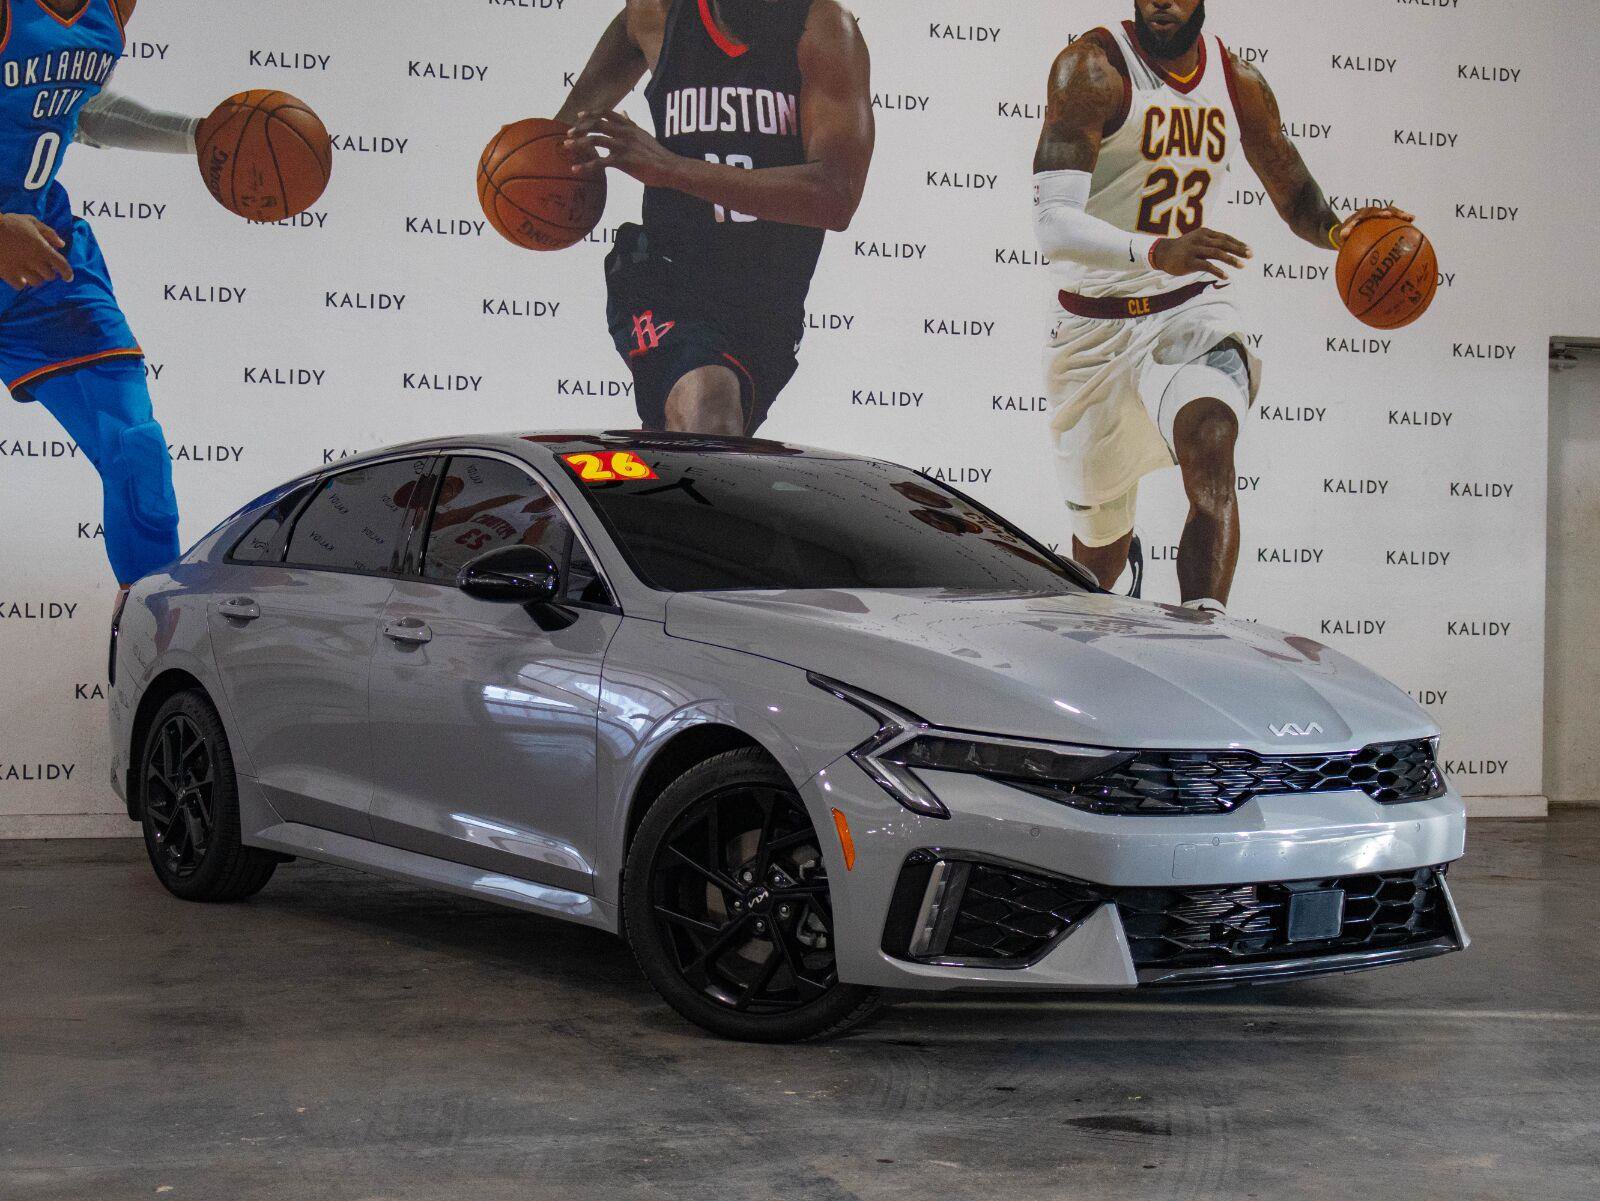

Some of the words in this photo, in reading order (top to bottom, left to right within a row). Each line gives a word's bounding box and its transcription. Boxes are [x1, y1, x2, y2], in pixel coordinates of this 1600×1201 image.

[930, 24, 1000, 42] KALIDY
[120, 43, 169, 59] IDY
[4, 50, 114, 87] OKLAHOM
[250, 50, 330, 70] KALIDY
[1333, 55, 1396, 72] KALIDY
[409, 61, 488, 81] KALIDY
[1459, 65, 1520, 82] KALIDY
[33, 88, 83, 118] CITY
[871, 94, 929, 111] ALIDY
[999, 102, 1048, 118] KALI
[665, 86, 798, 138] HOUSTON
[1140, 105, 1226, 163] CAVS
[1281, 123, 1331, 139] ALIDY
[1395, 130, 1457, 147] KALIDY
[331, 135, 408, 153] KALIDY
[24, 131, 60, 190] 0
[927, 172, 997, 189] KALIDY
[1136, 166, 1212, 238] 23
[1227, 190, 1265, 205] IDY
[83, 201, 166, 220] KALIDY
[1456, 204, 1518, 220] KALIDY
[406, 217, 485, 236] KALIDY
[855, 241, 926, 258] KALIDY
[996, 249, 1050, 265] KALID
[1264, 264, 1328, 280] KALIDY
[165, 285, 246, 303] KALIDY
[326, 292, 405, 309] KALIDY
[483, 299, 559, 317] KALIDY
[1127, 297, 1151, 316] CLE
[802, 314, 854, 330] LIDY
[925, 319, 994, 336] KALIDY
[1327, 338, 1390, 353] KALIDY
[1453, 344, 1515, 359] KALIDY
[245, 368, 325, 385] KALIDY
[404, 373, 482, 391] KALIDY
[558, 380, 634, 396] KALIDY
[853, 391, 923, 407] KALIDY
[993, 396, 1047, 412] KALID
[1261, 406, 1325, 421] KALIDY
[1389, 411, 1452, 425] KALIDY
[566, 452, 650, 480] 26
[1324, 479, 1388, 494] KALIDY
[1451, 483, 1512, 497] KALIDY
[1152, 545, 1179, 560] LID
[1258, 548, 1323, 563] KALIDY
[1387, 551, 1449, 565] KALIDY
[1322, 620, 1385, 634] KALIDY
[1448, 622, 1510, 635] KALIDY
[1418, 691, 1447, 704] IDY
[1445, 760, 1508, 775] KALIDY
